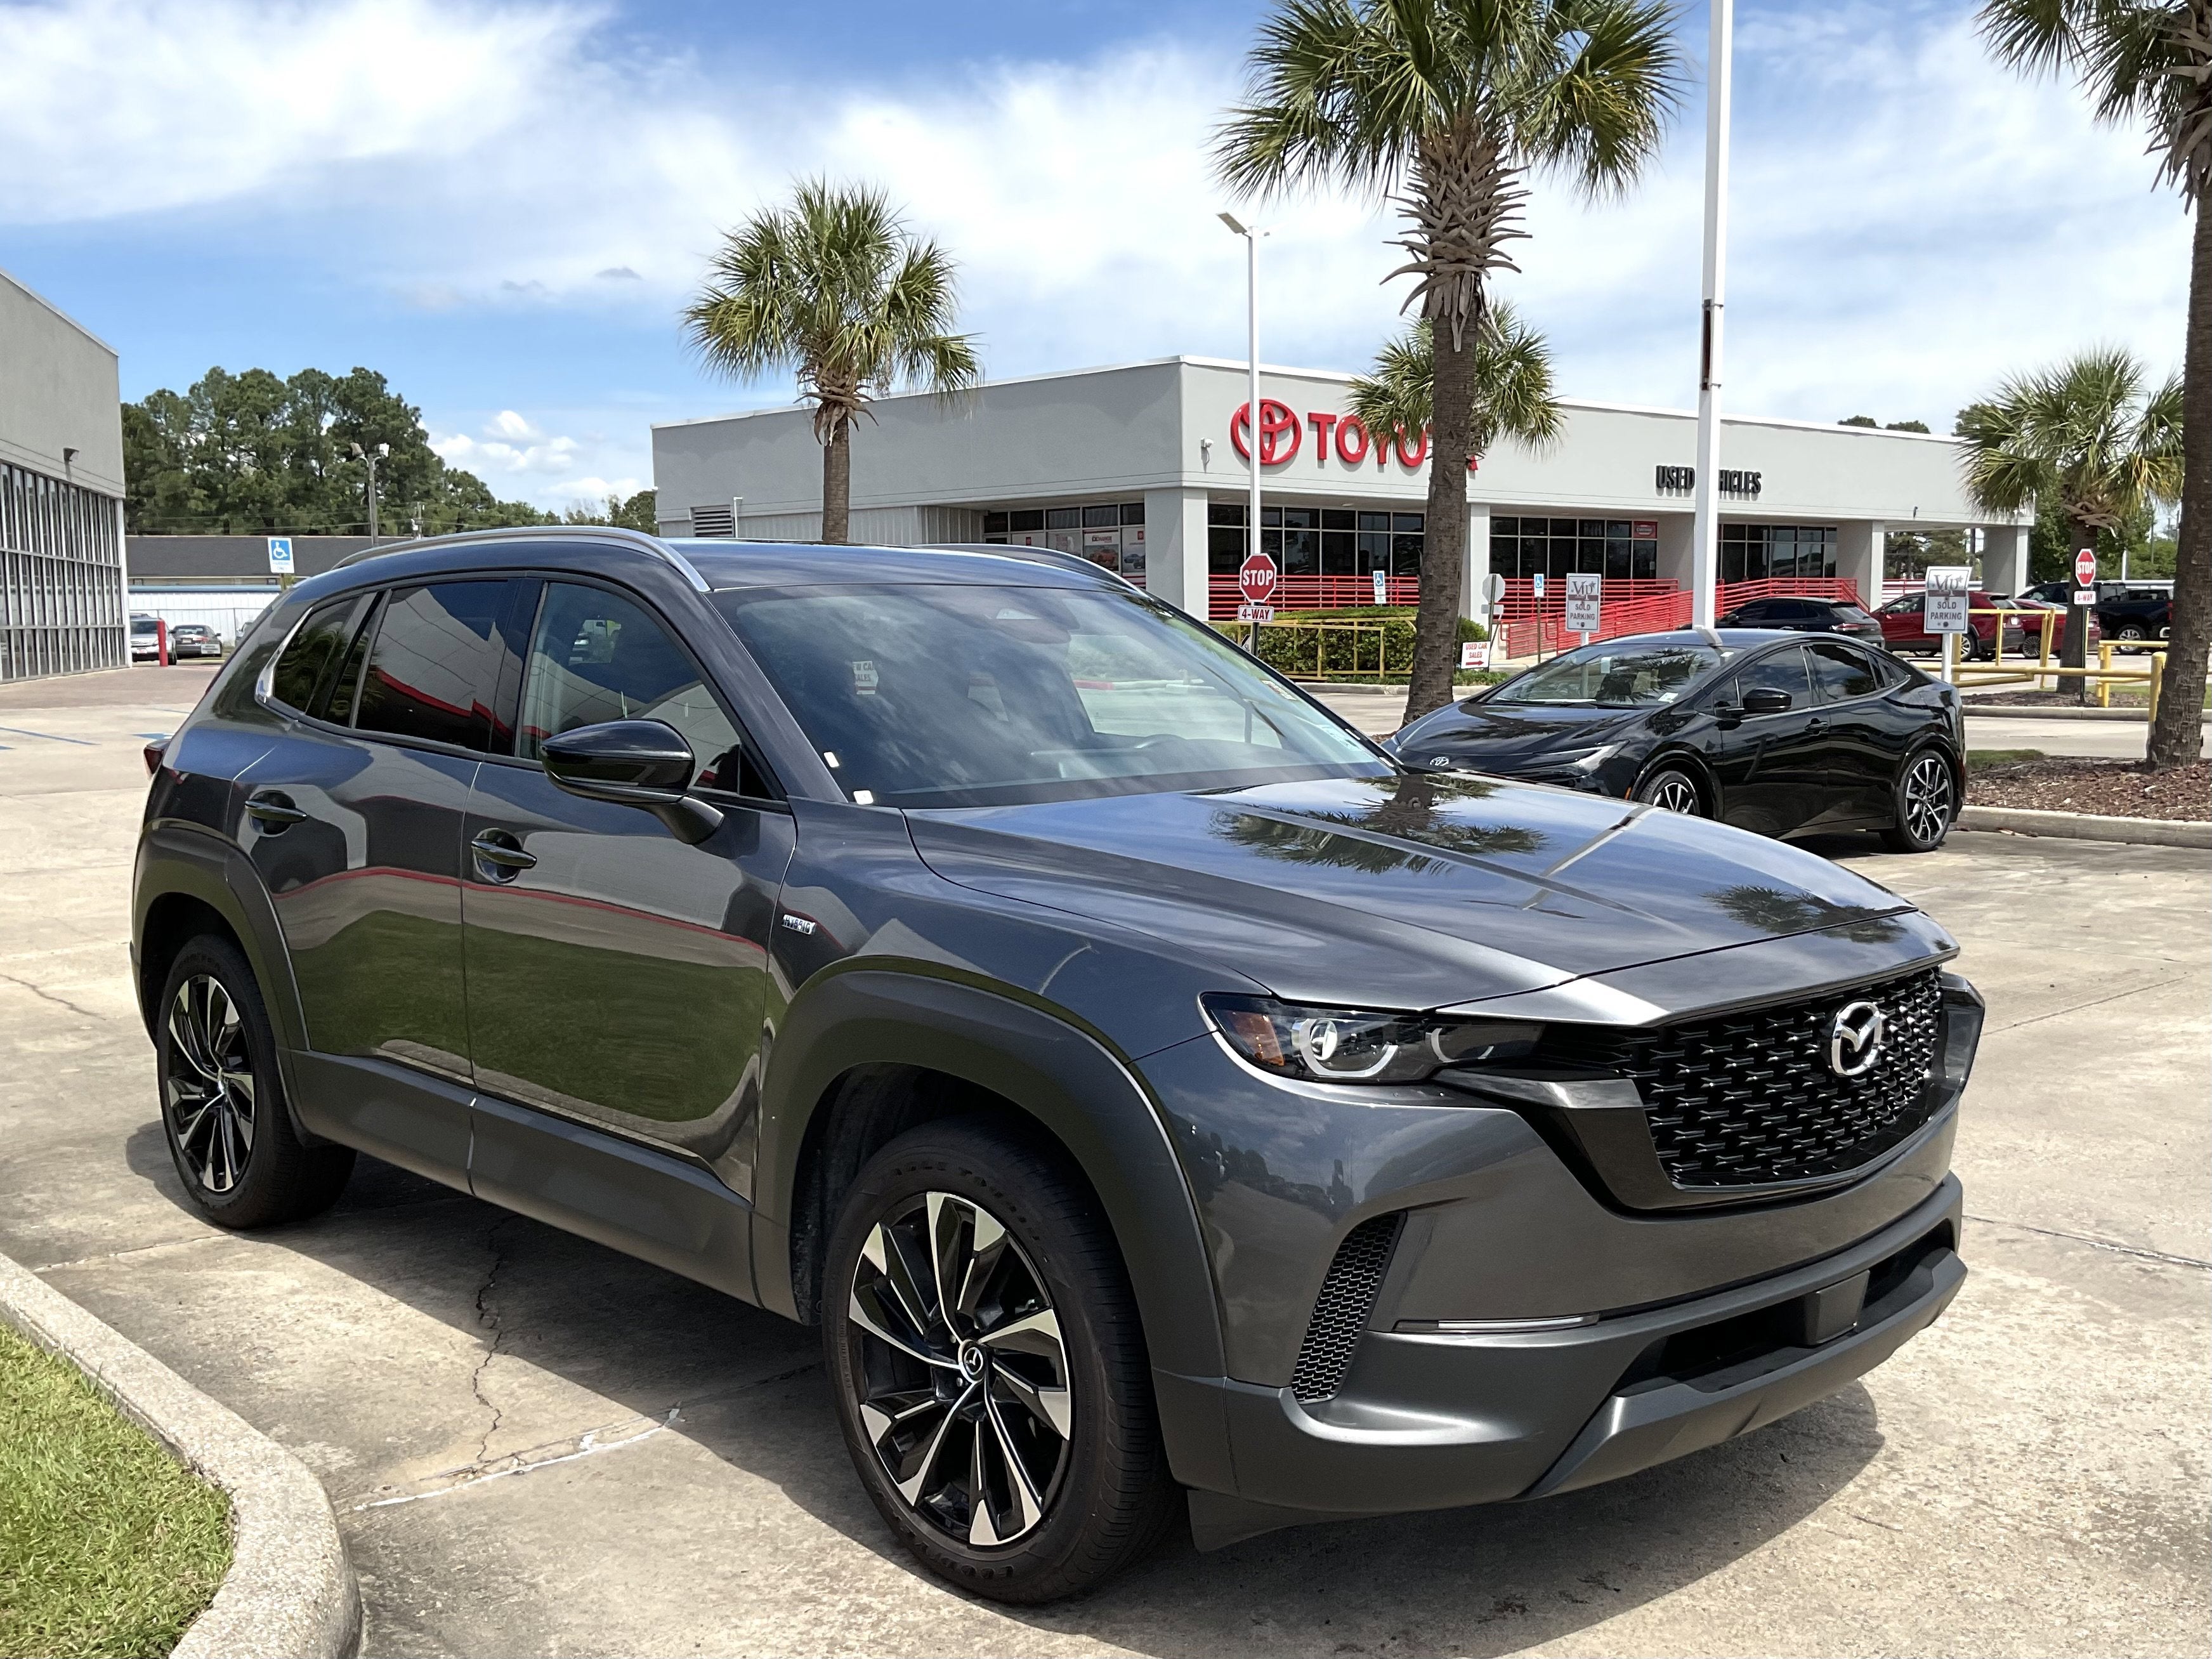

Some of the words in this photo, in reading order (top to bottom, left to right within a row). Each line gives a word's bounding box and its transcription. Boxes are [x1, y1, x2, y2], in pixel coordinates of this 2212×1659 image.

[1308, 412, 1478, 470] TOYO
[1656, 465, 1695, 490] USED
[1718, 469, 1762, 494] HICLES
[2077, 561, 2094, 574] STOP
[1242, 569, 1274, 586] STOP
[2078, 593, 2093, 601] 4-WAY
[1241, 608, 1270, 620] 4-WAY
